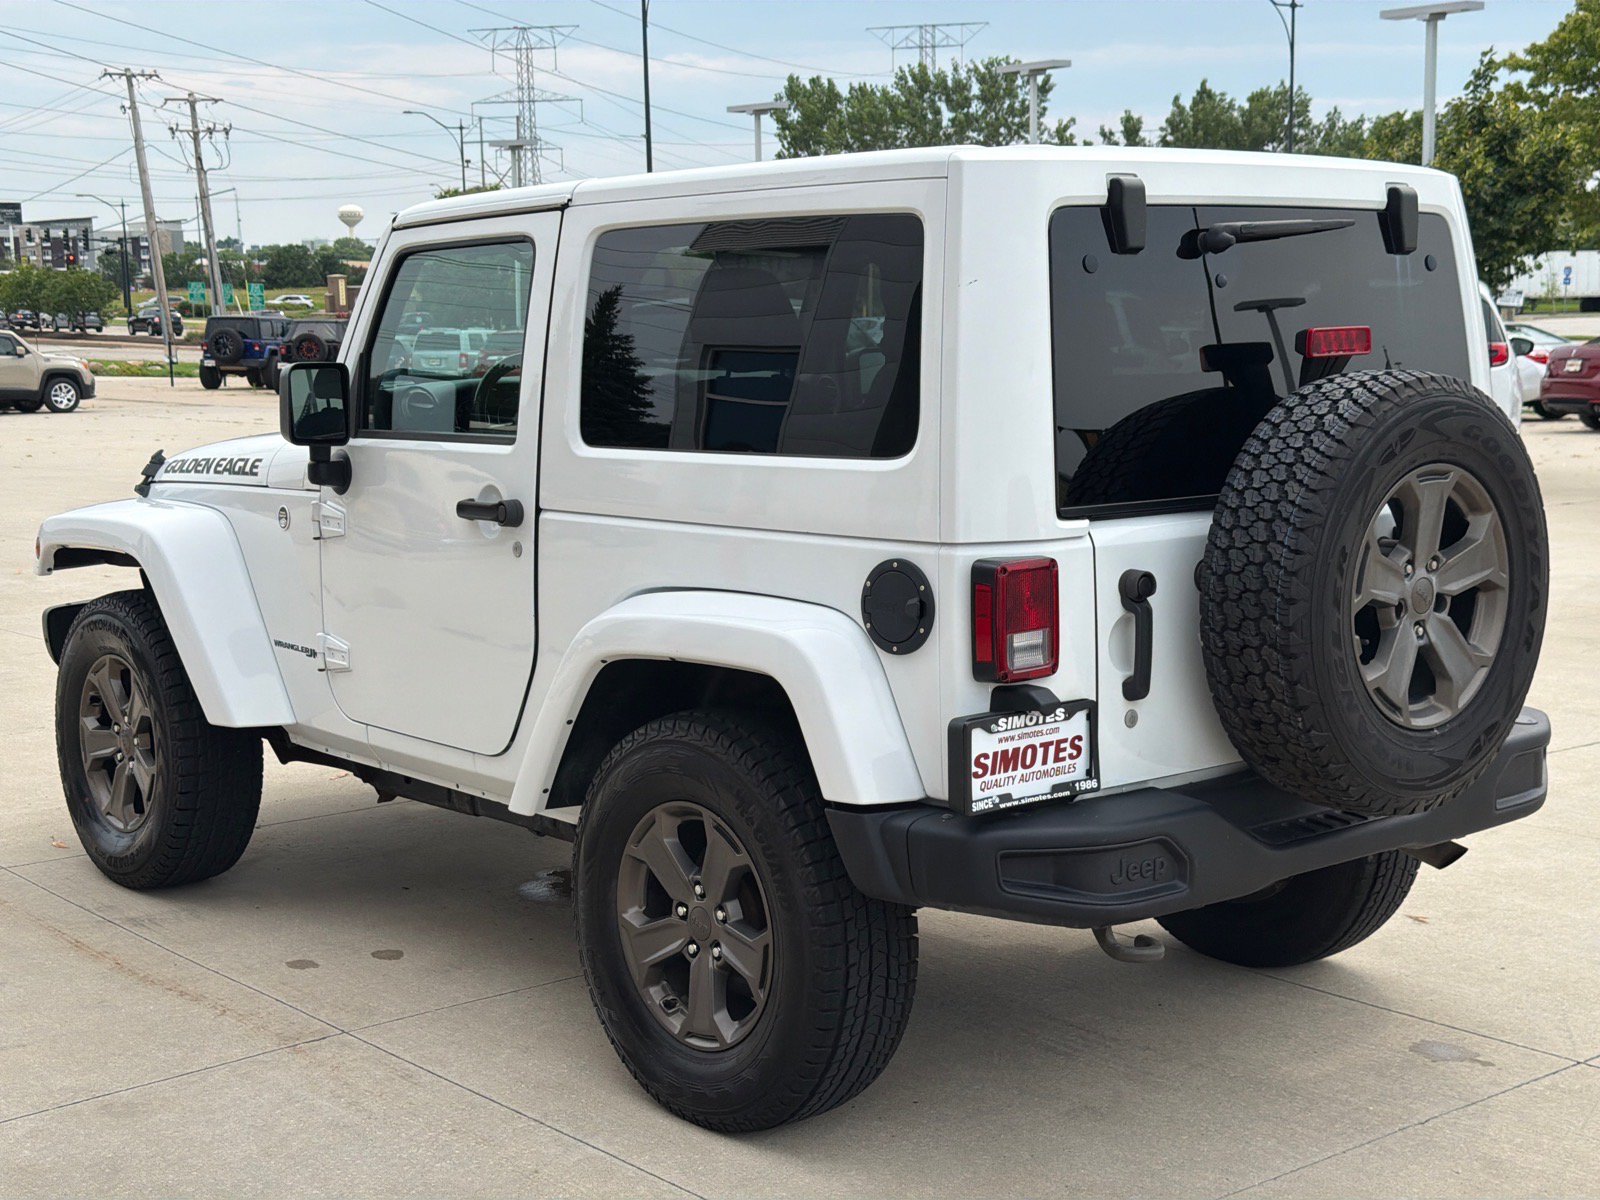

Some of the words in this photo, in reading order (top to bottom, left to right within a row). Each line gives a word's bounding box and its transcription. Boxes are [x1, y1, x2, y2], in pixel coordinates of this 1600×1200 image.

[164, 458, 215, 474] GOLDEN
[213, 458, 263, 476] EAGLE
[273, 639, 309, 654] WRANGLER
[998, 726, 1060, 744] www.simotes.com
[972, 735, 1083, 779] SIMOTES
[980, 775, 1017, 792] QUALITY
[1018, 762, 1077, 784] AUTOMOBILES
[1074, 779, 1098, 792] 1986
[972, 799, 994, 812] SINCE
[999, 790, 1070, 809] www.simotes.com
[1110, 855, 1167, 886] Jeep
